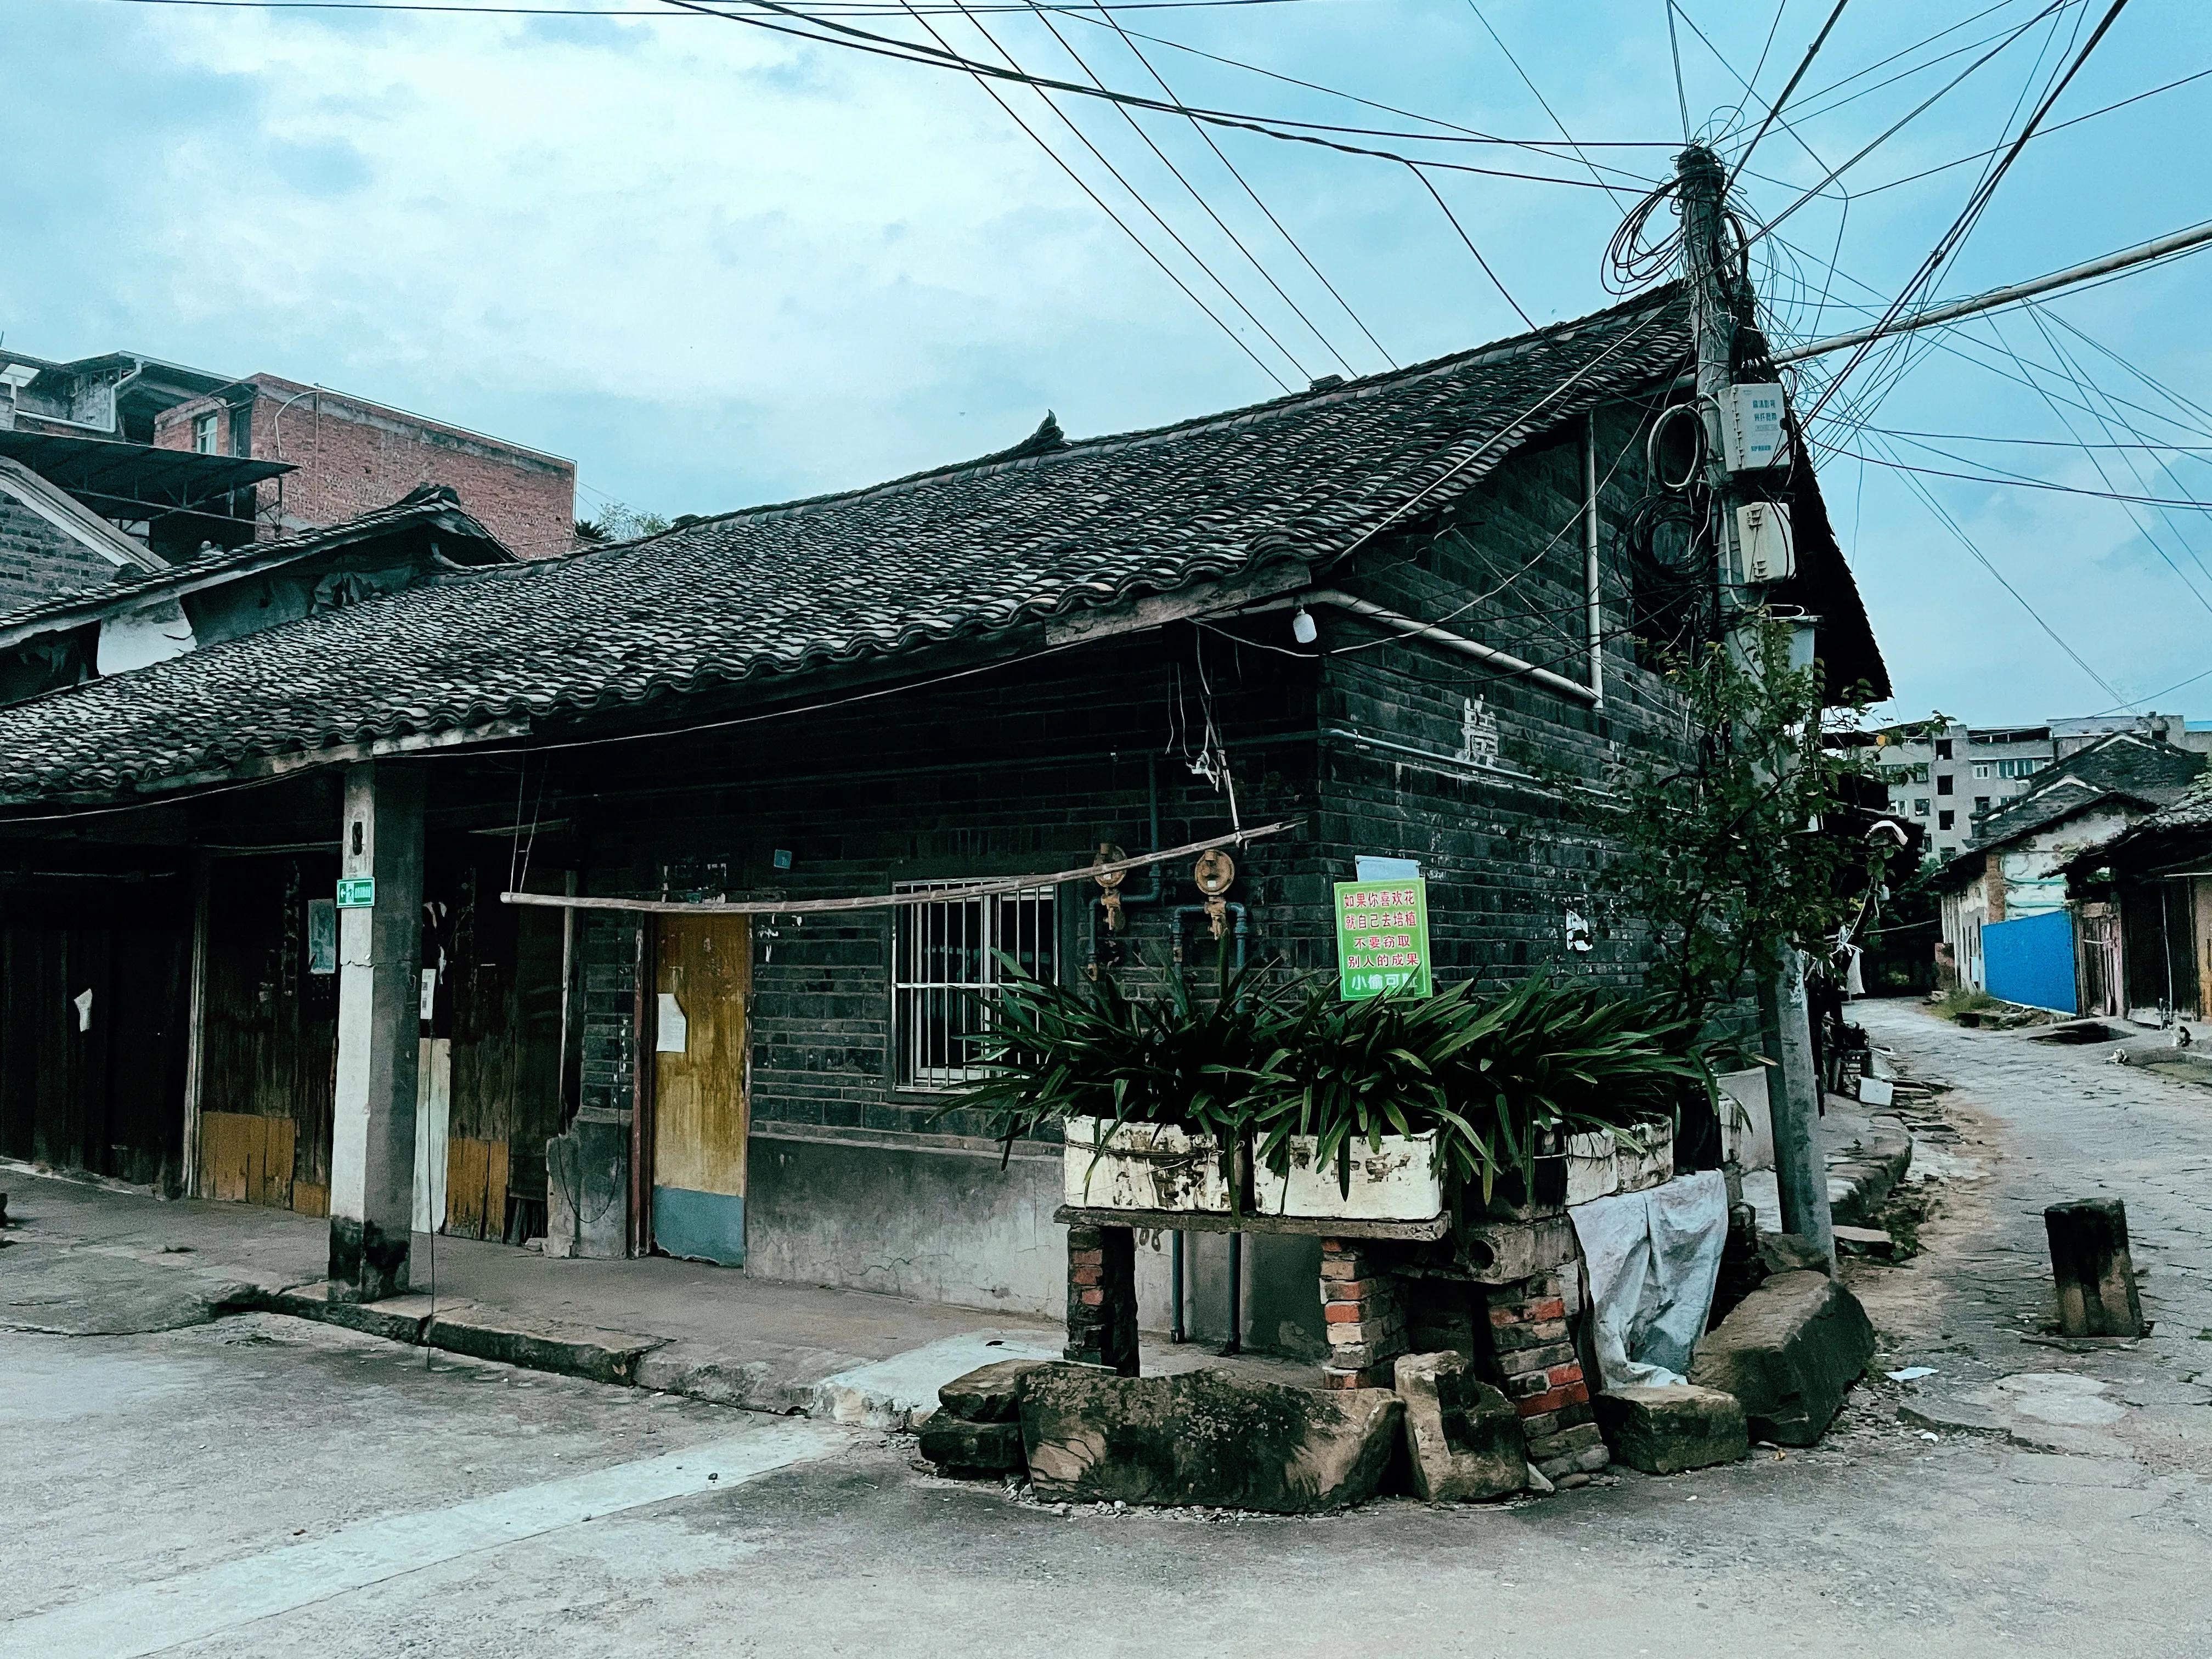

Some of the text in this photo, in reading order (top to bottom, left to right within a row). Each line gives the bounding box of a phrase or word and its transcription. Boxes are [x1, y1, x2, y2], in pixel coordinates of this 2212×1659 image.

[1344, 890, 1415, 909] 如果你喜欢花
[1346, 911, 1416, 929] 就自己去培植
[1354, 935, 1410, 949] 不要窃取
[1348, 953, 1419, 968] 别人的成果
